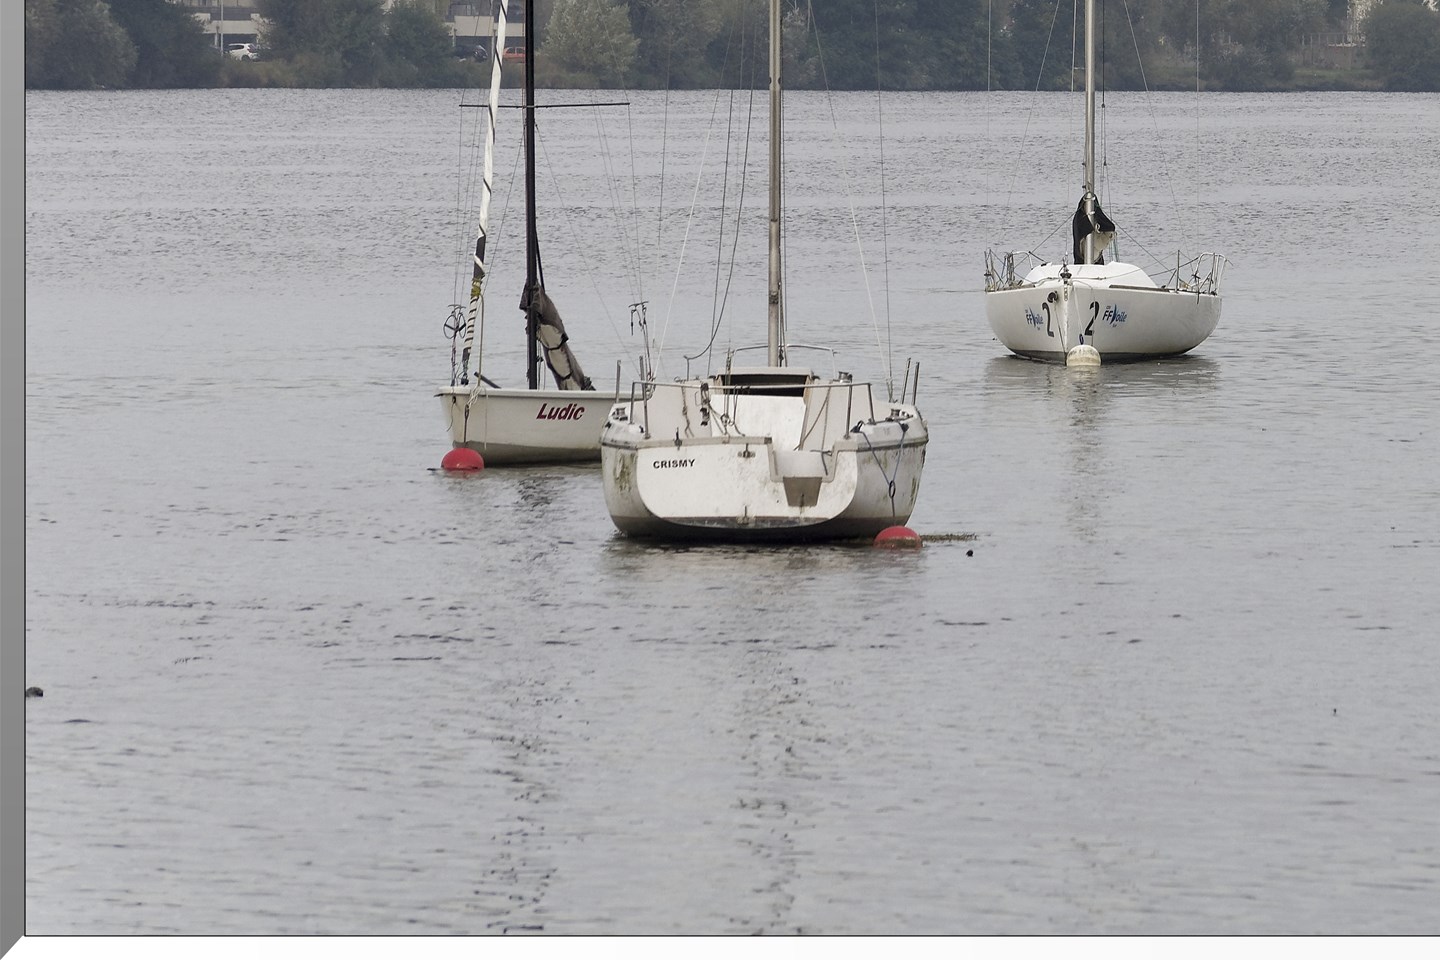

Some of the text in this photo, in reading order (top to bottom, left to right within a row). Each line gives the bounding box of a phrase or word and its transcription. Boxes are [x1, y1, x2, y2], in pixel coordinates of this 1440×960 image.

[1085, 301, 1100, 336] 2
[536, 403, 585, 421] Ludic
[653, 459, 695, 469] CRISMY
